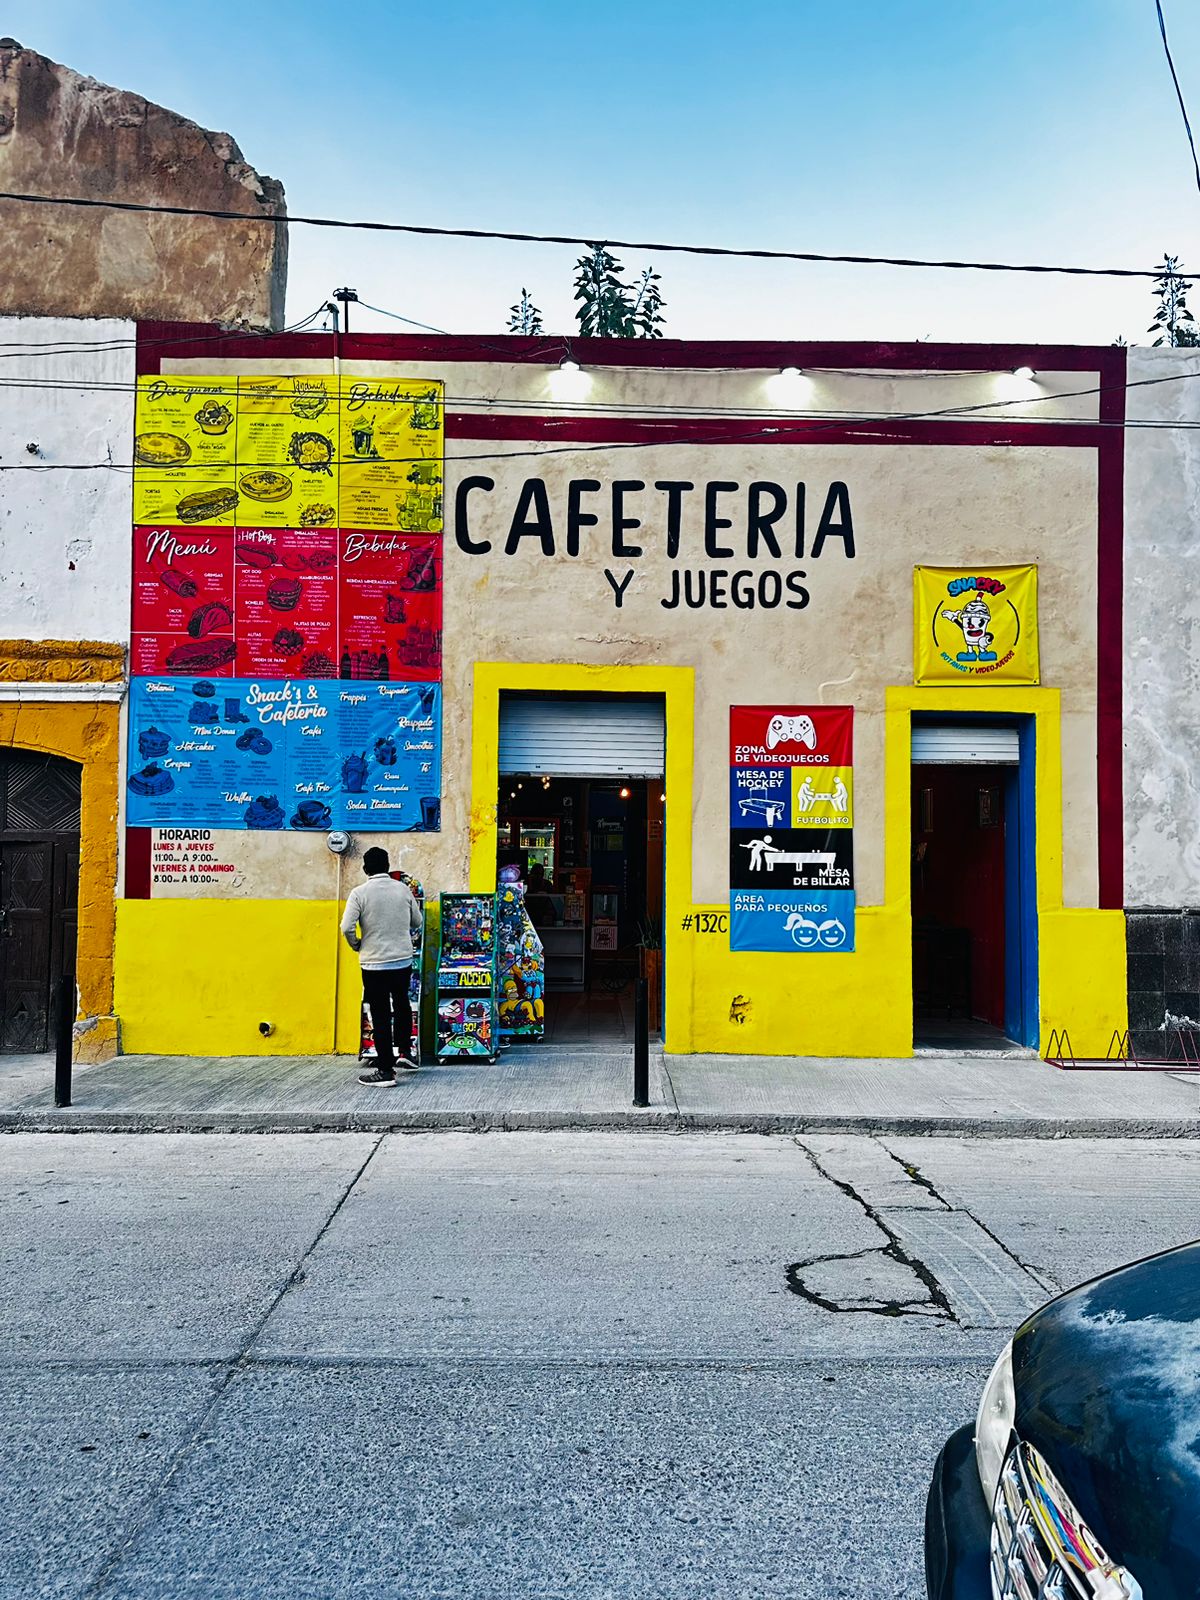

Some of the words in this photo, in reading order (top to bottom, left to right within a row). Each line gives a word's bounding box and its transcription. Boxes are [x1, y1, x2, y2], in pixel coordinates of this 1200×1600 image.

[454, 476, 856, 558] CAFETERIA
[241, 531, 257, 543] Hot
[258, 530, 276, 545] Dog
[146, 530, 217, 565] Menú
[343, 533, 411, 562] Bebidas
[604, 568, 635, 610] Y
[660, 568, 811, 610] JUEGOS
[246, 681, 302, 705] Snack's
[306, 684, 319, 700] &
[257, 701, 328, 727] Cafeteria
[213, 726, 236, 735] Donas
[735, 745, 766, 754] ZONA
[735, 754, 750, 763] DE
[753, 754, 830, 763] VIDEOJUEGOS
[736, 770, 767, 779] MESA
[769, 770, 784, 779] DE
[738, 779, 783, 788] HOCKEY
[346, 800, 367, 810] Sodas
[796, 816, 849, 824] FUTBOLITO
[159, 829, 211, 841] HORARIO
[153, 843, 175, 851] LUNES
[177, 843, 182, 851] A
[185, 843, 214, 851] JUEVES
[182, 854, 189, 862] A
[152, 864, 187, 872] VIERNES
[189, 864, 196, 872] A
[198, 864, 235, 872] DOMINGO
[818, 868, 850, 877] MESA
[182, 875, 188, 883] A
[793, 877, 809, 886] DE
[811, 877, 850, 886] BILLAR
[734, 893, 765, 903] ÁREA
[735, 904, 765, 912] PARA
[768, 902, 828, 913] PEQUEÑOS
[682, 914, 728, 934] #132C
